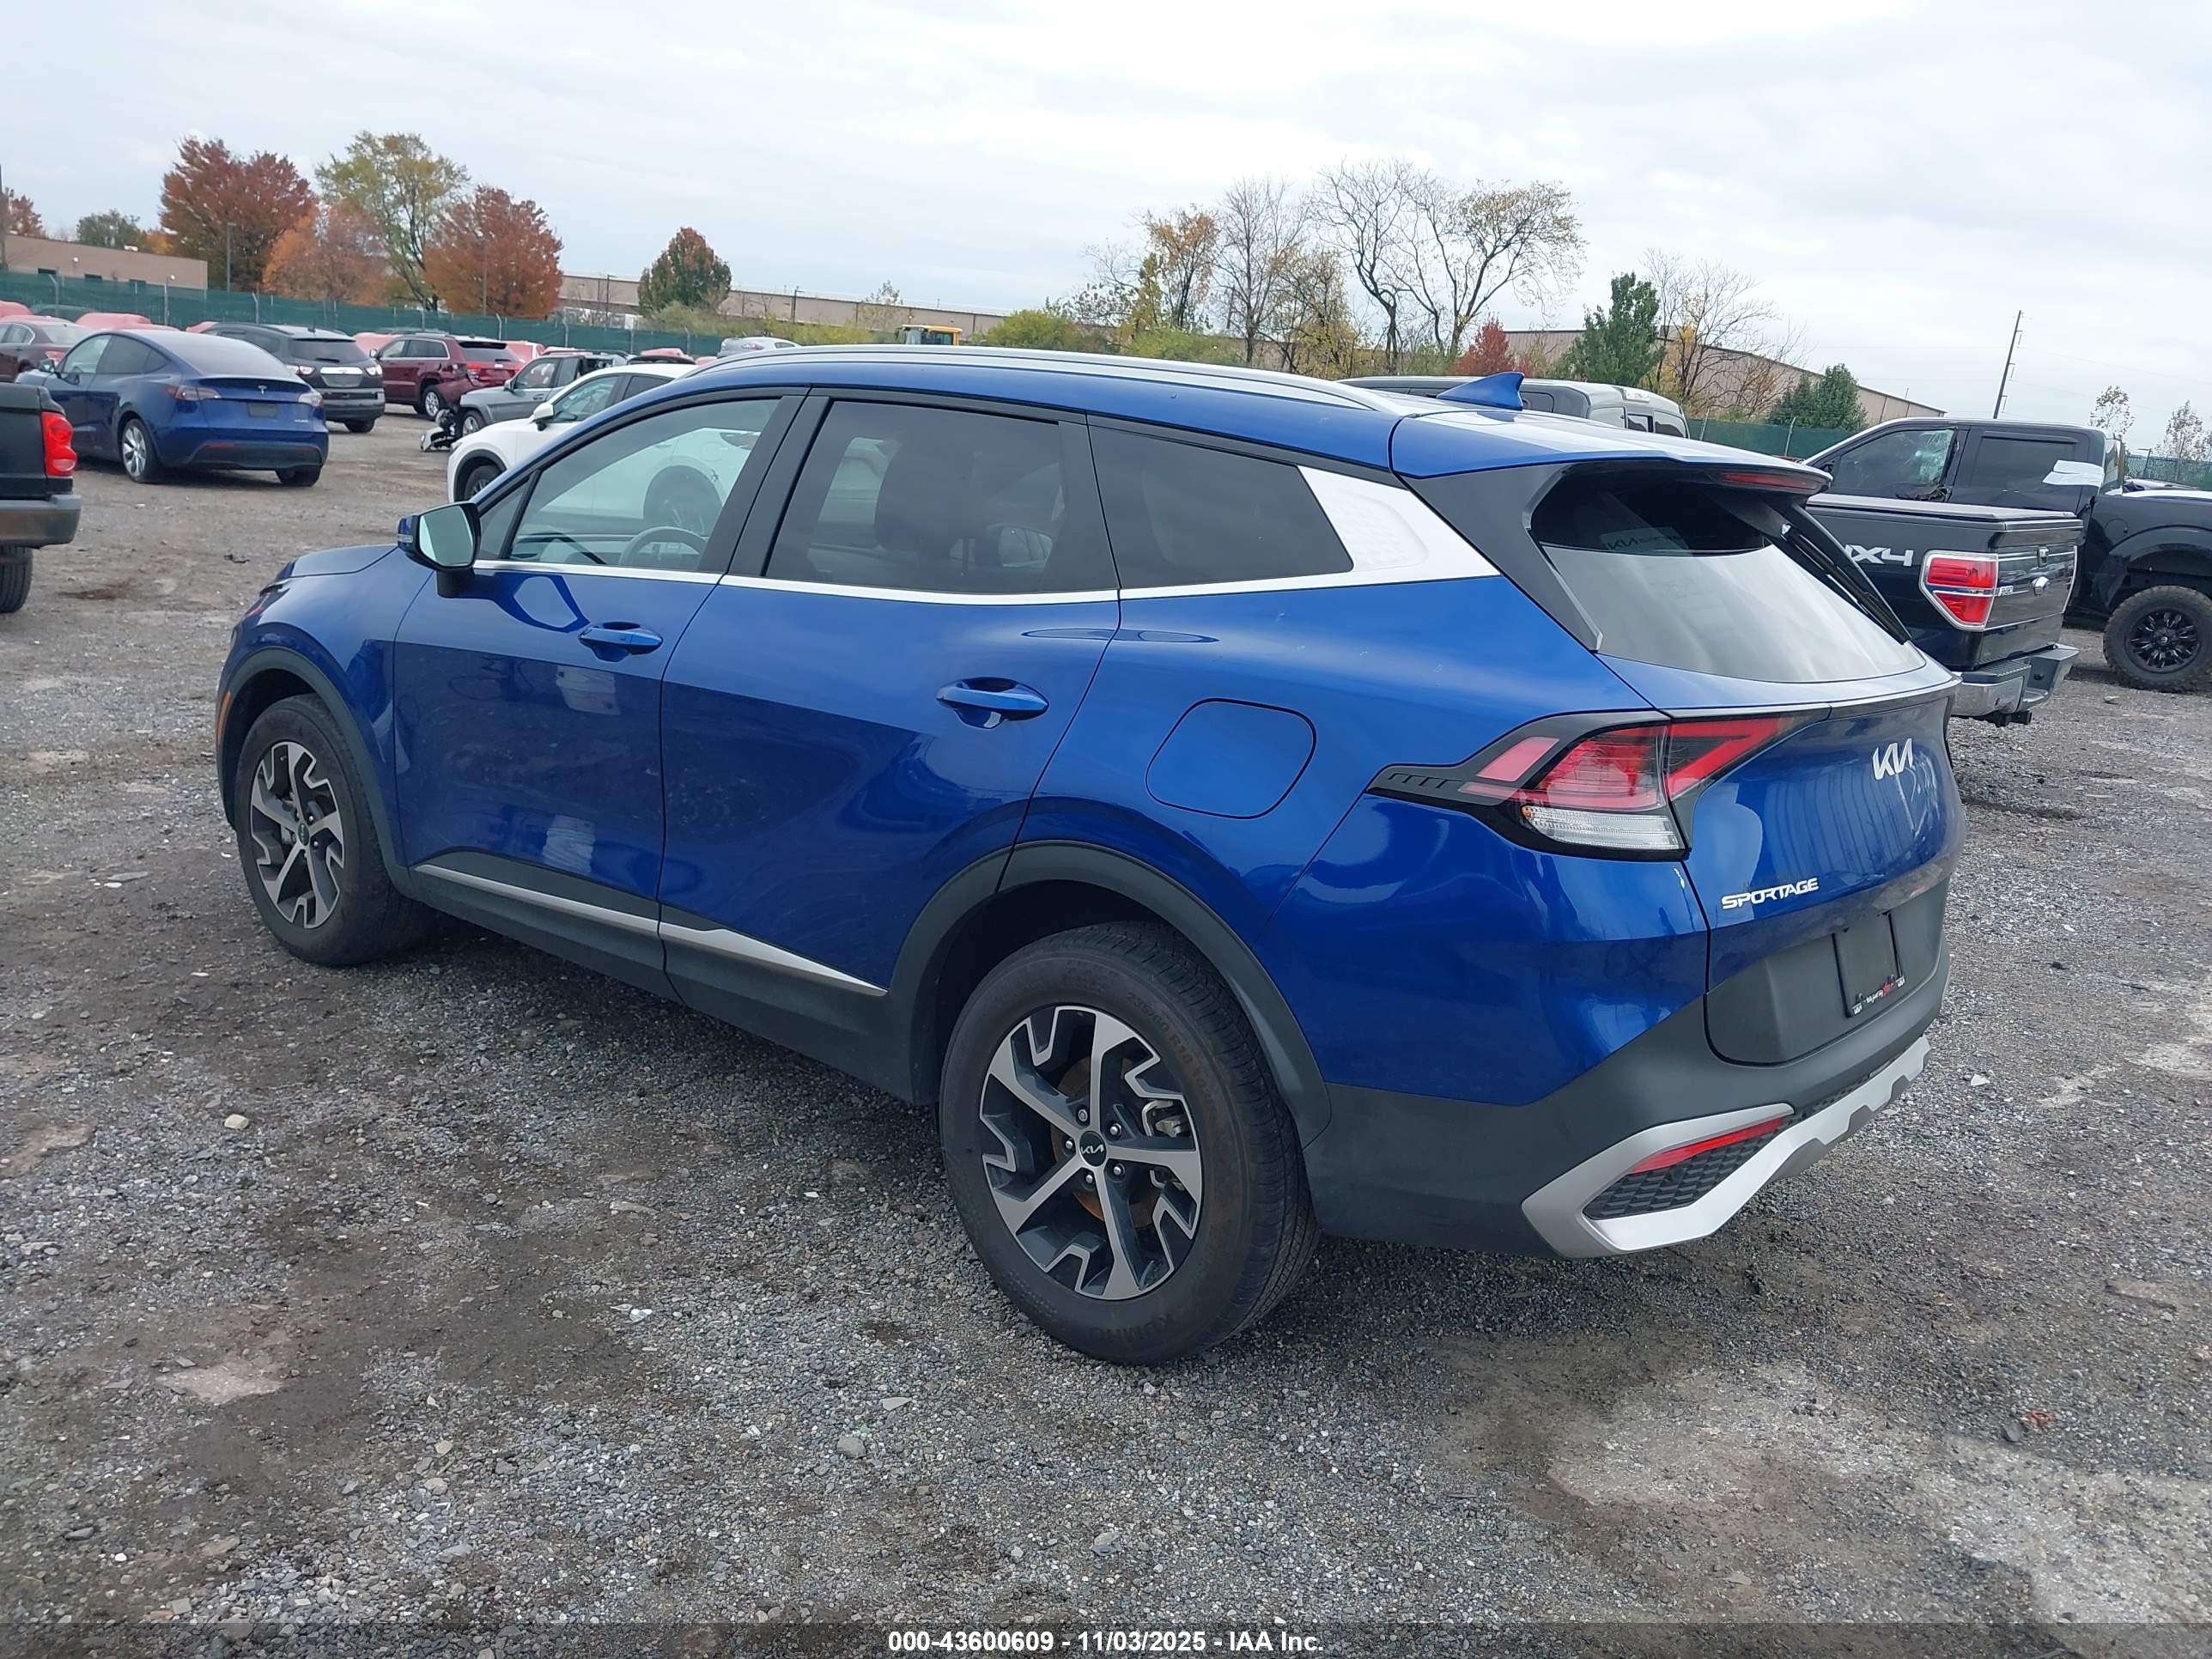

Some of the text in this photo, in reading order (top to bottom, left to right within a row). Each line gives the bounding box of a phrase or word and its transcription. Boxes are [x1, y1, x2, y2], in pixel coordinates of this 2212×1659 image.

[1873, 738, 1913, 780] KIA
[1722, 878, 1820, 910] SPORTAGE
[1080, 1144, 1104, 1155] KIA
